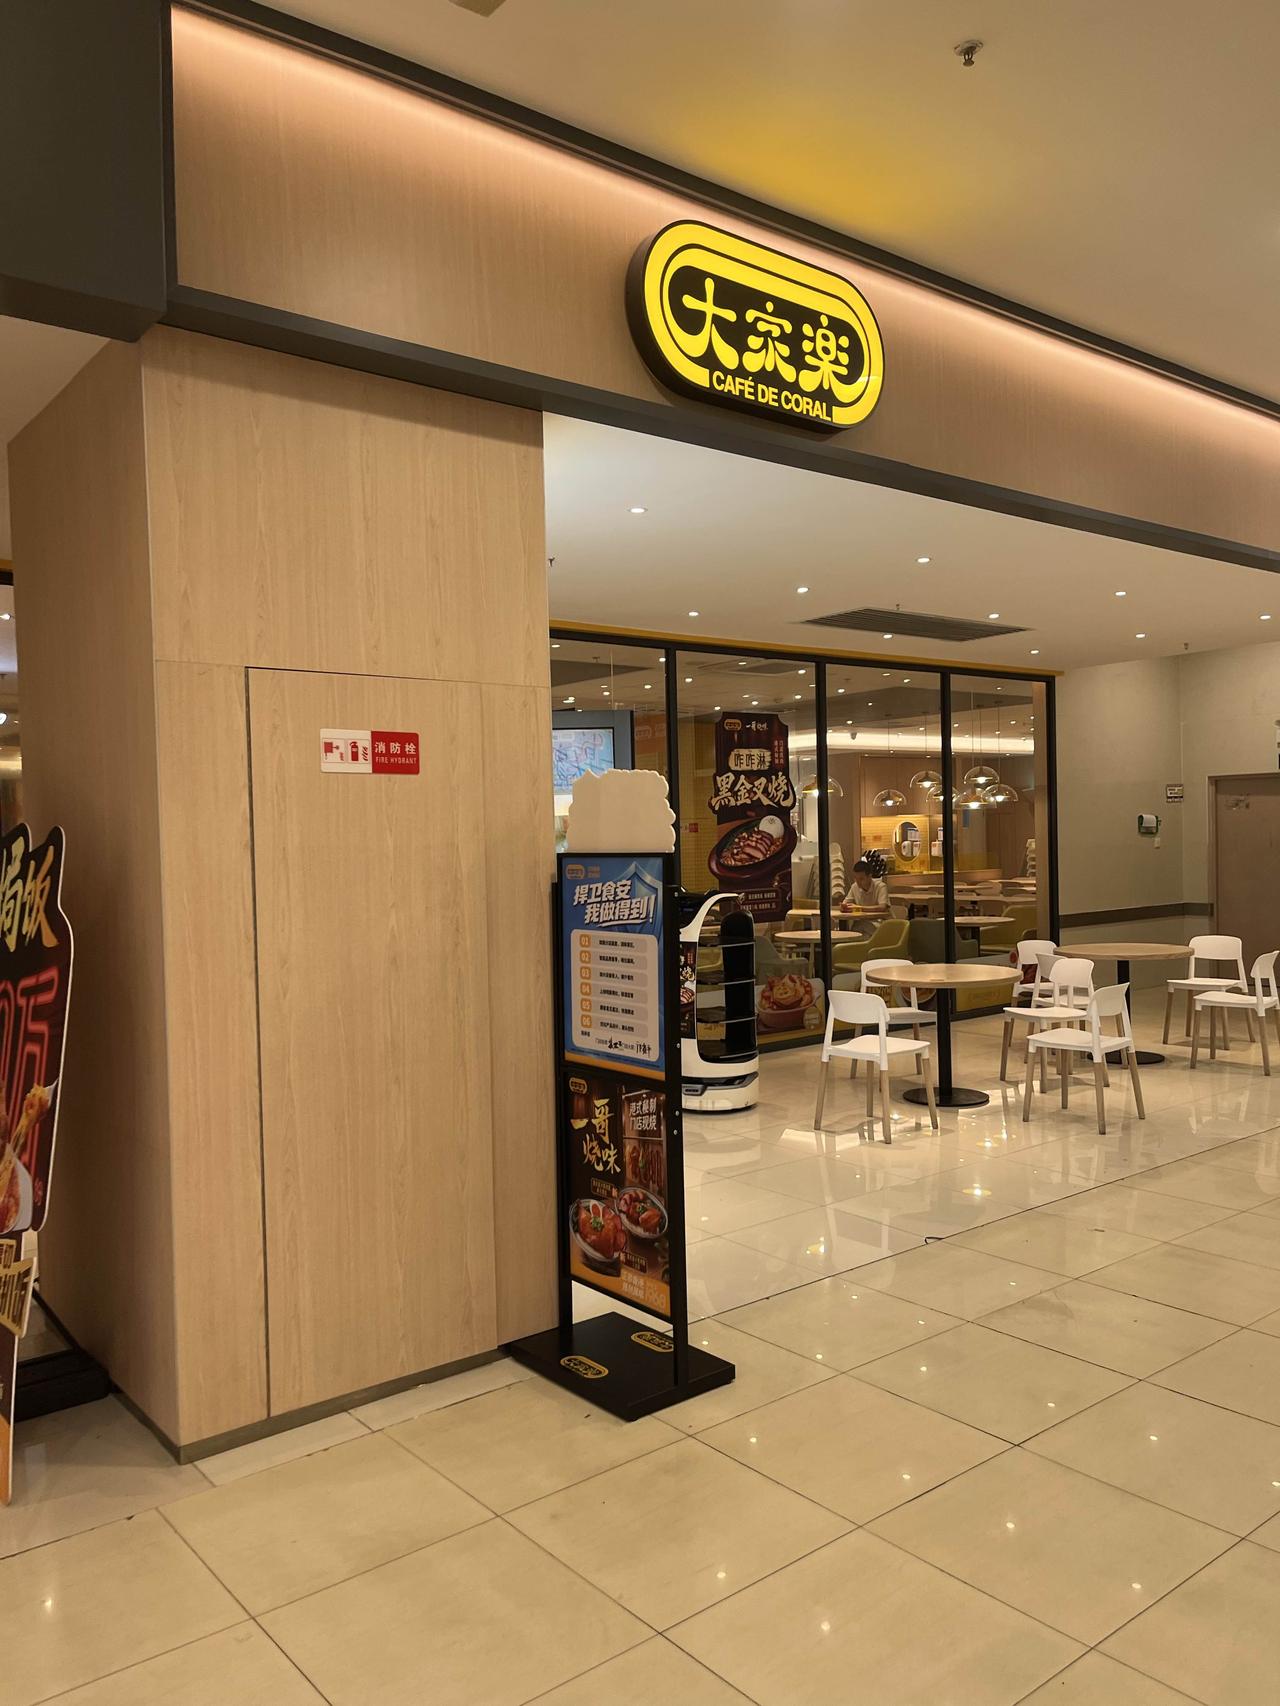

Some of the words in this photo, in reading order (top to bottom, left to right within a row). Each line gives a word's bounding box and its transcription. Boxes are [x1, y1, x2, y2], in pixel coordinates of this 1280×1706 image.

[712, 371, 755, 400] CAFÉ
[758, 387, 779, 406] DE
[781, 391, 832, 422] CORAL
[375, 741, 416, 754] 消防栓
[375, 756, 388, 764] FIRE
[734, 752, 767, 769] 咋咋淋
[710, 772, 793, 811] 黑金叉烧
[570, 1098, 615, 1145] 一哥
[582, 1133, 622, 1175] 烧味
